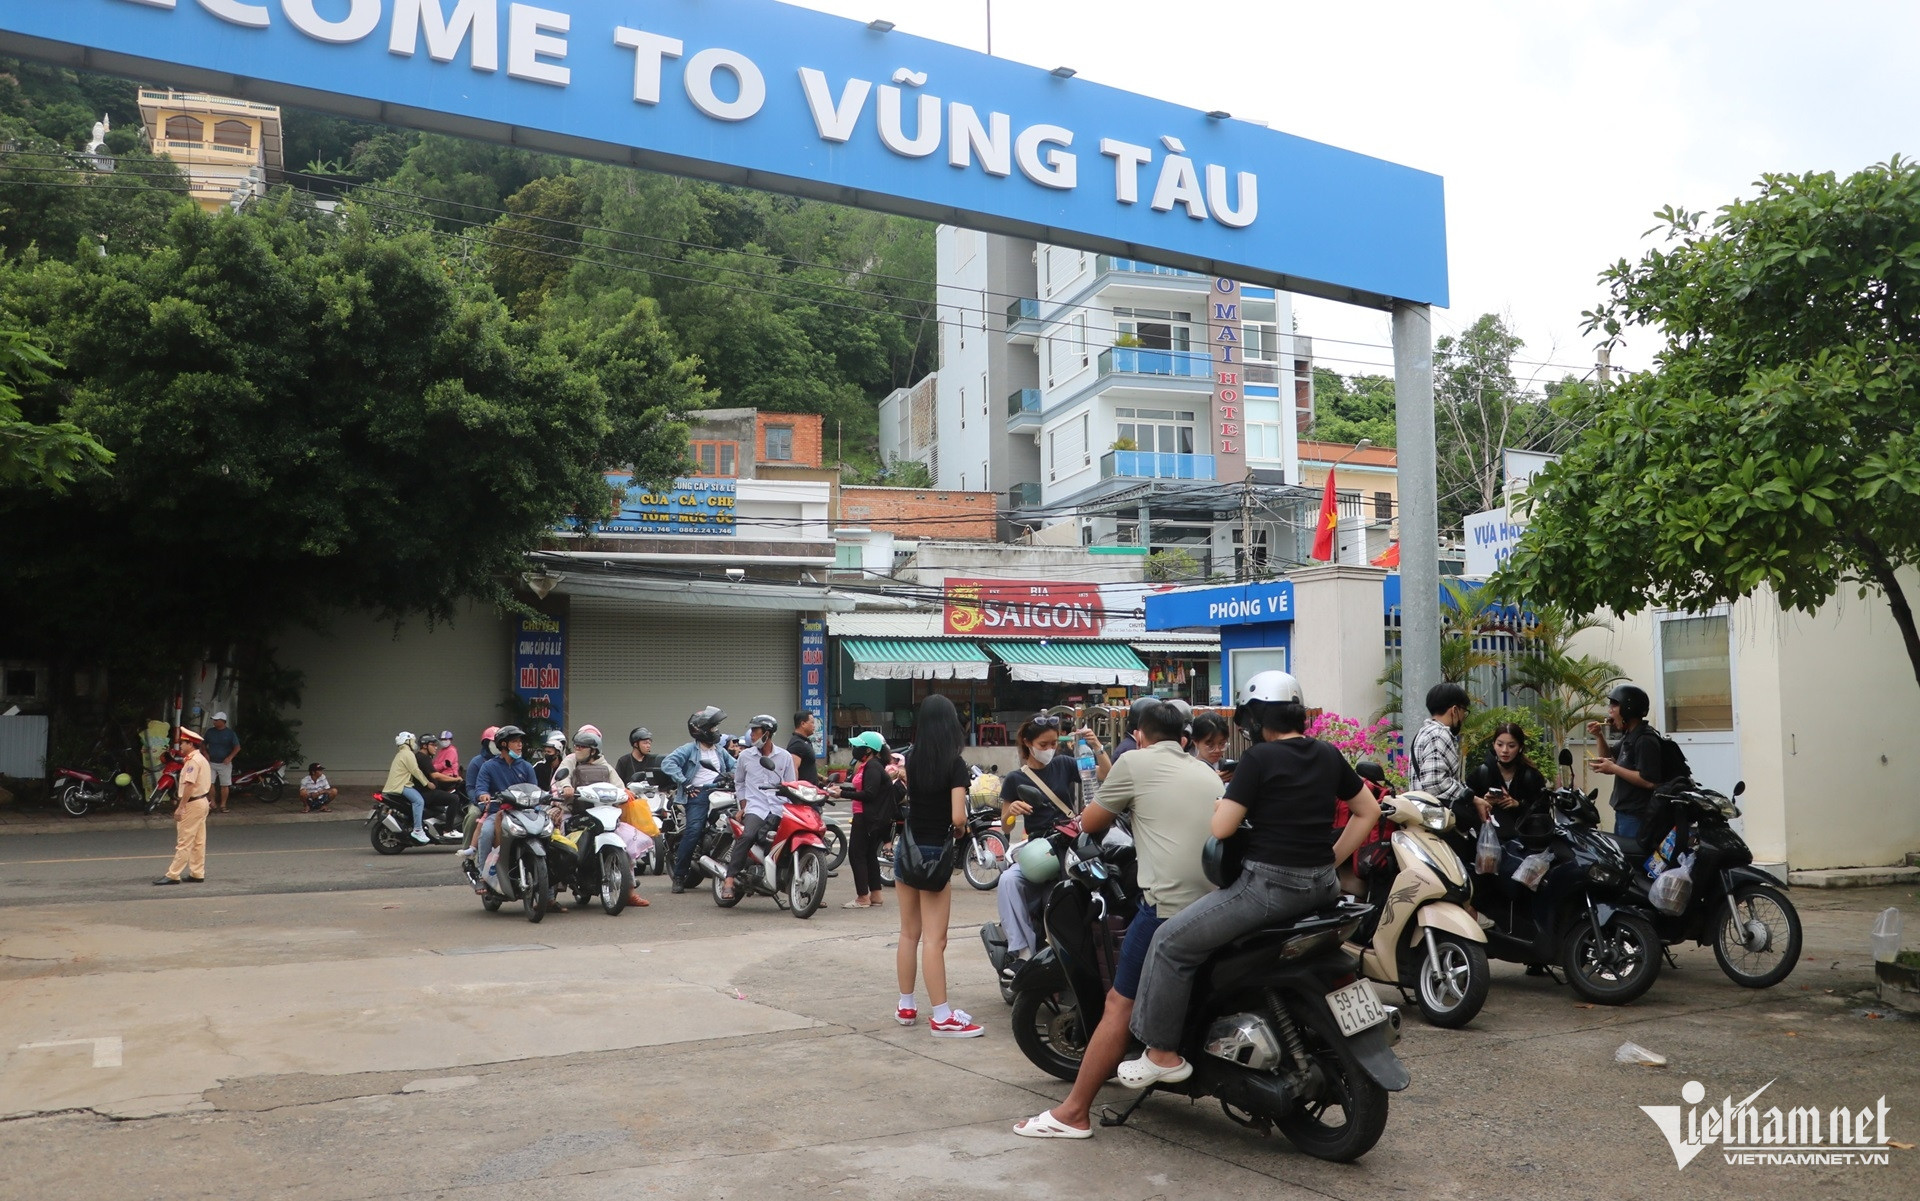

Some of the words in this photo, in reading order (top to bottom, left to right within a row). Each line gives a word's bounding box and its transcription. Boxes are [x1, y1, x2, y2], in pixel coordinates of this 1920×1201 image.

[613, 25, 766, 122] TO
[798, 67, 1077, 189] VŨNG
[1100, 135, 1258, 228] TÀU
[1213, 303, 1237, 362] MAI
[1217, 371, 1239, 453] HOTEL
[679, 493, 697, 506] CÁ
[707, 496, 735, 510] GHẸ
[1474, 521, 1497, 549] VỰA
[984, 600, 1093, 628] SAIGON
[1209, 597, 1261, 619] PHÒNG
[1267, 590, 1288, 613] VÉ
[520, 662, 538, 689] HẢI
[539, 663, 560, 690] SẢN
[1334, 984, 1369, 1011] 59-Z1
[1340, 1001, 1383, 1031] 414.64
